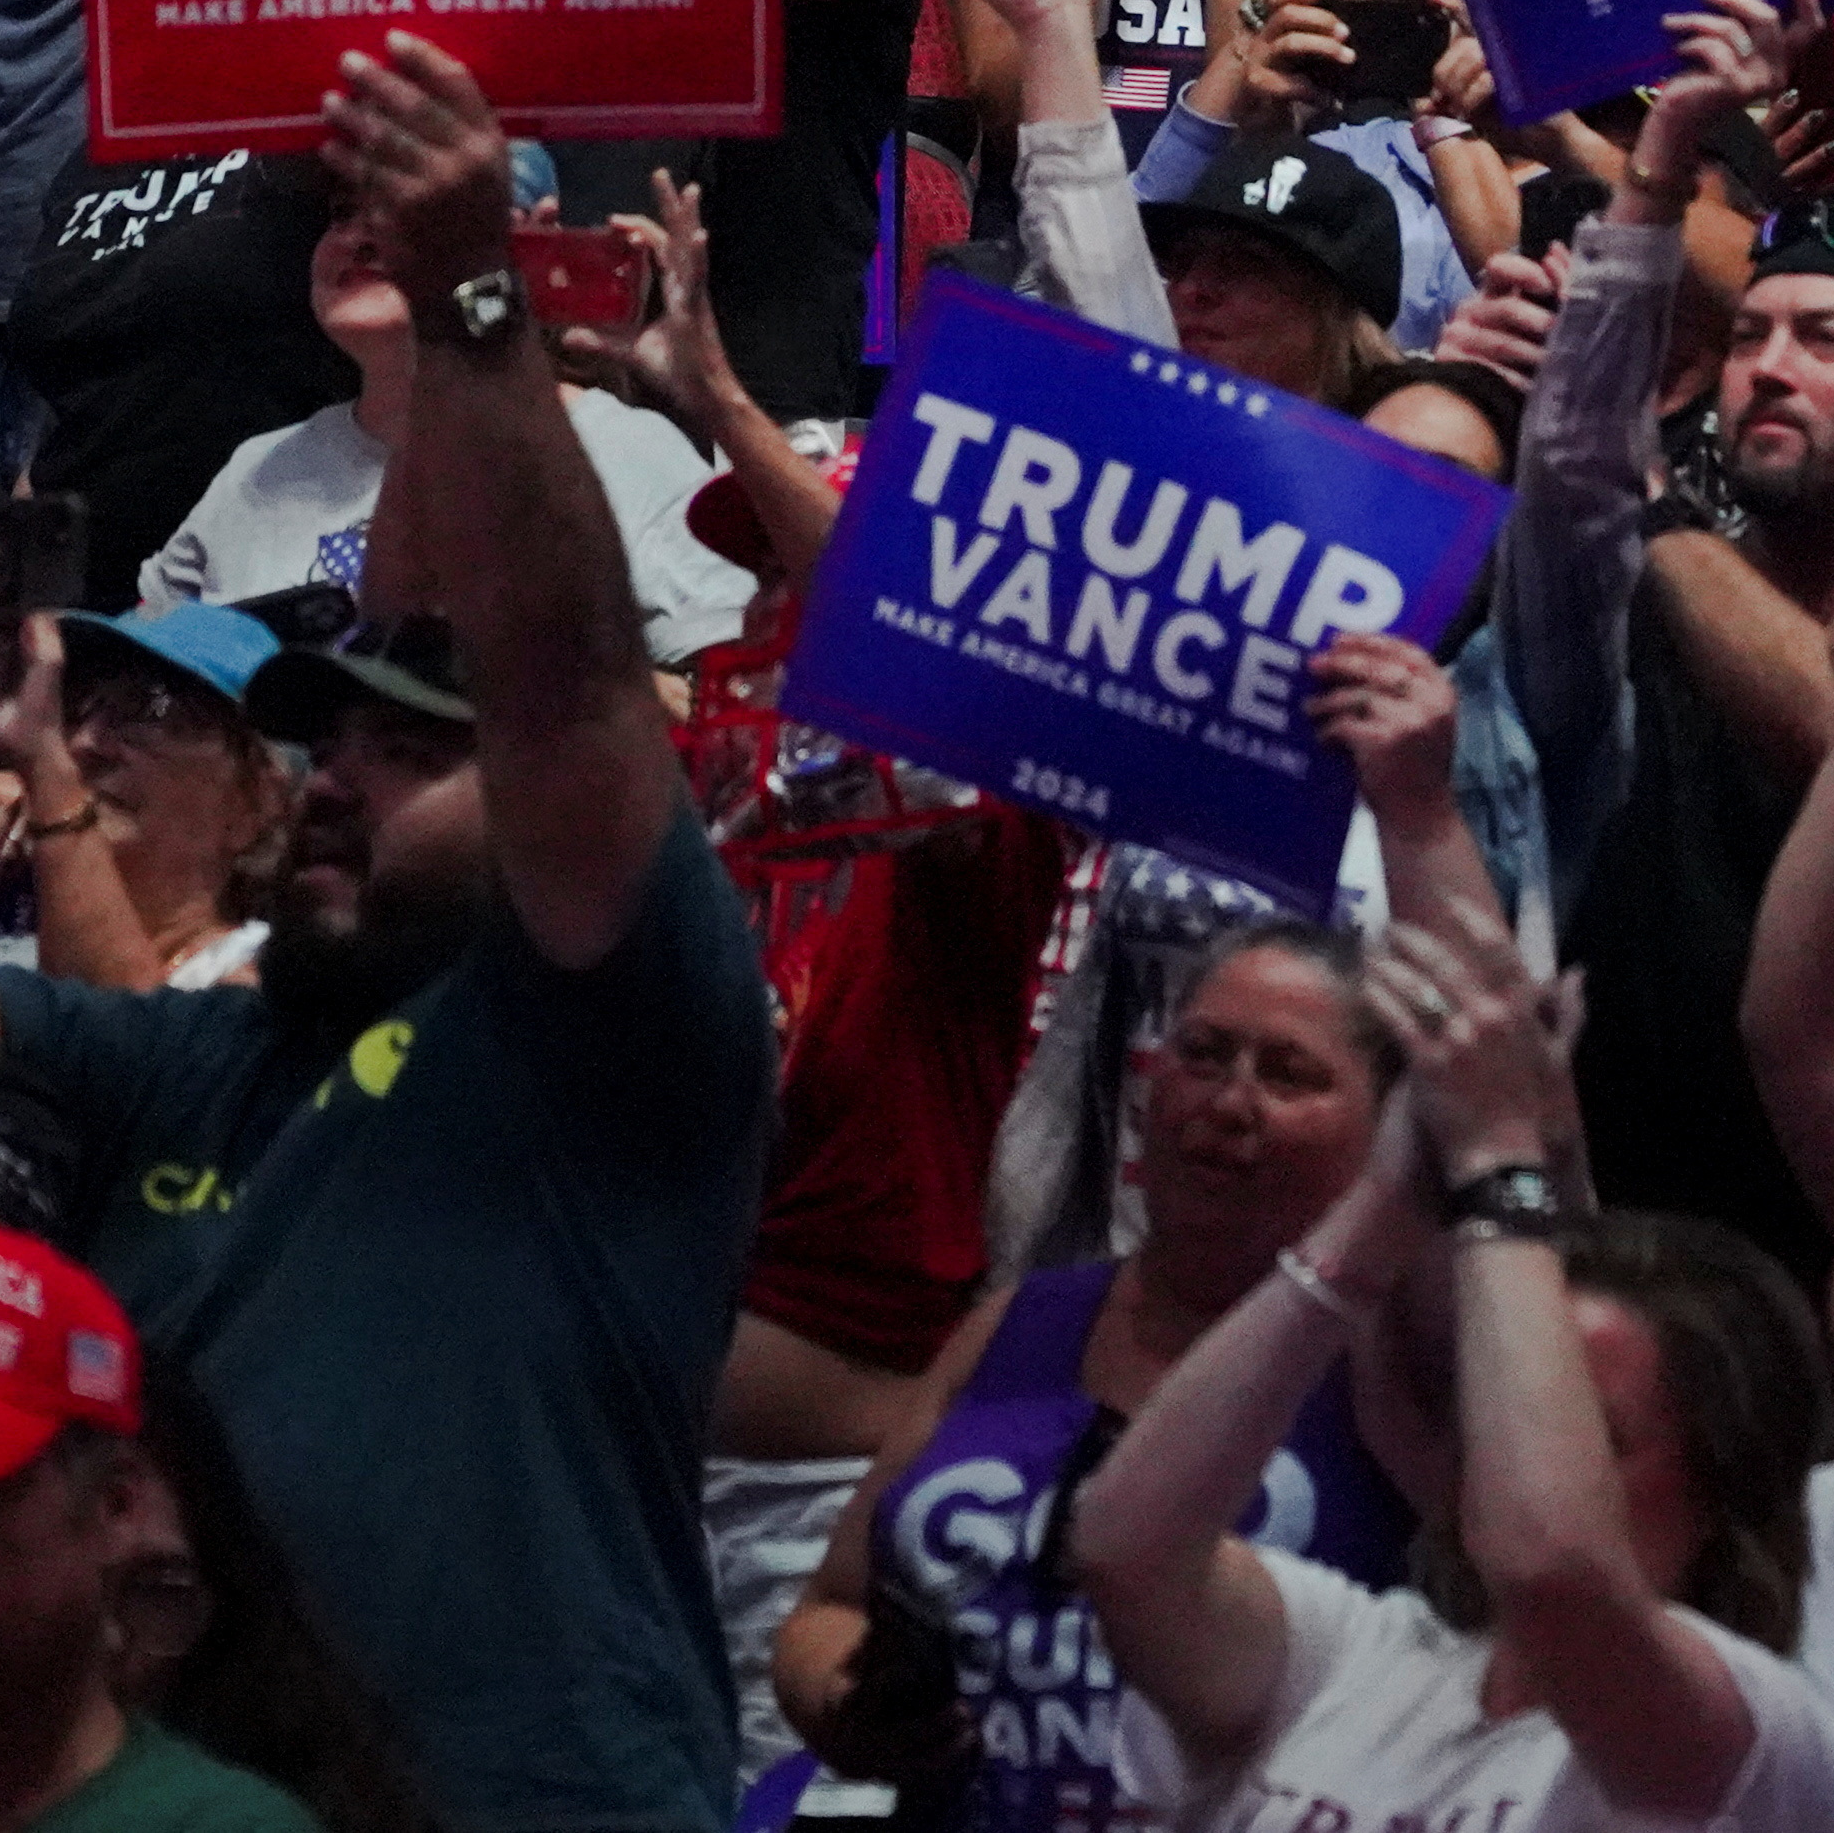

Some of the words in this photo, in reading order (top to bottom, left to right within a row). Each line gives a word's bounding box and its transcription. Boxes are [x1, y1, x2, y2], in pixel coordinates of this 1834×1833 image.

[65, 148, 249, 228] TRUMP
[910, 392, 1406, 648] TRUMP
[873, 595, 958, 644] MAKE
[959, 631, 1092, 699] AMERICA
[1096, 679, 1198, 742] GREAT
[928, 516, 1307, 732] VANCE
[1010, 757, 1112, 815] 2024
